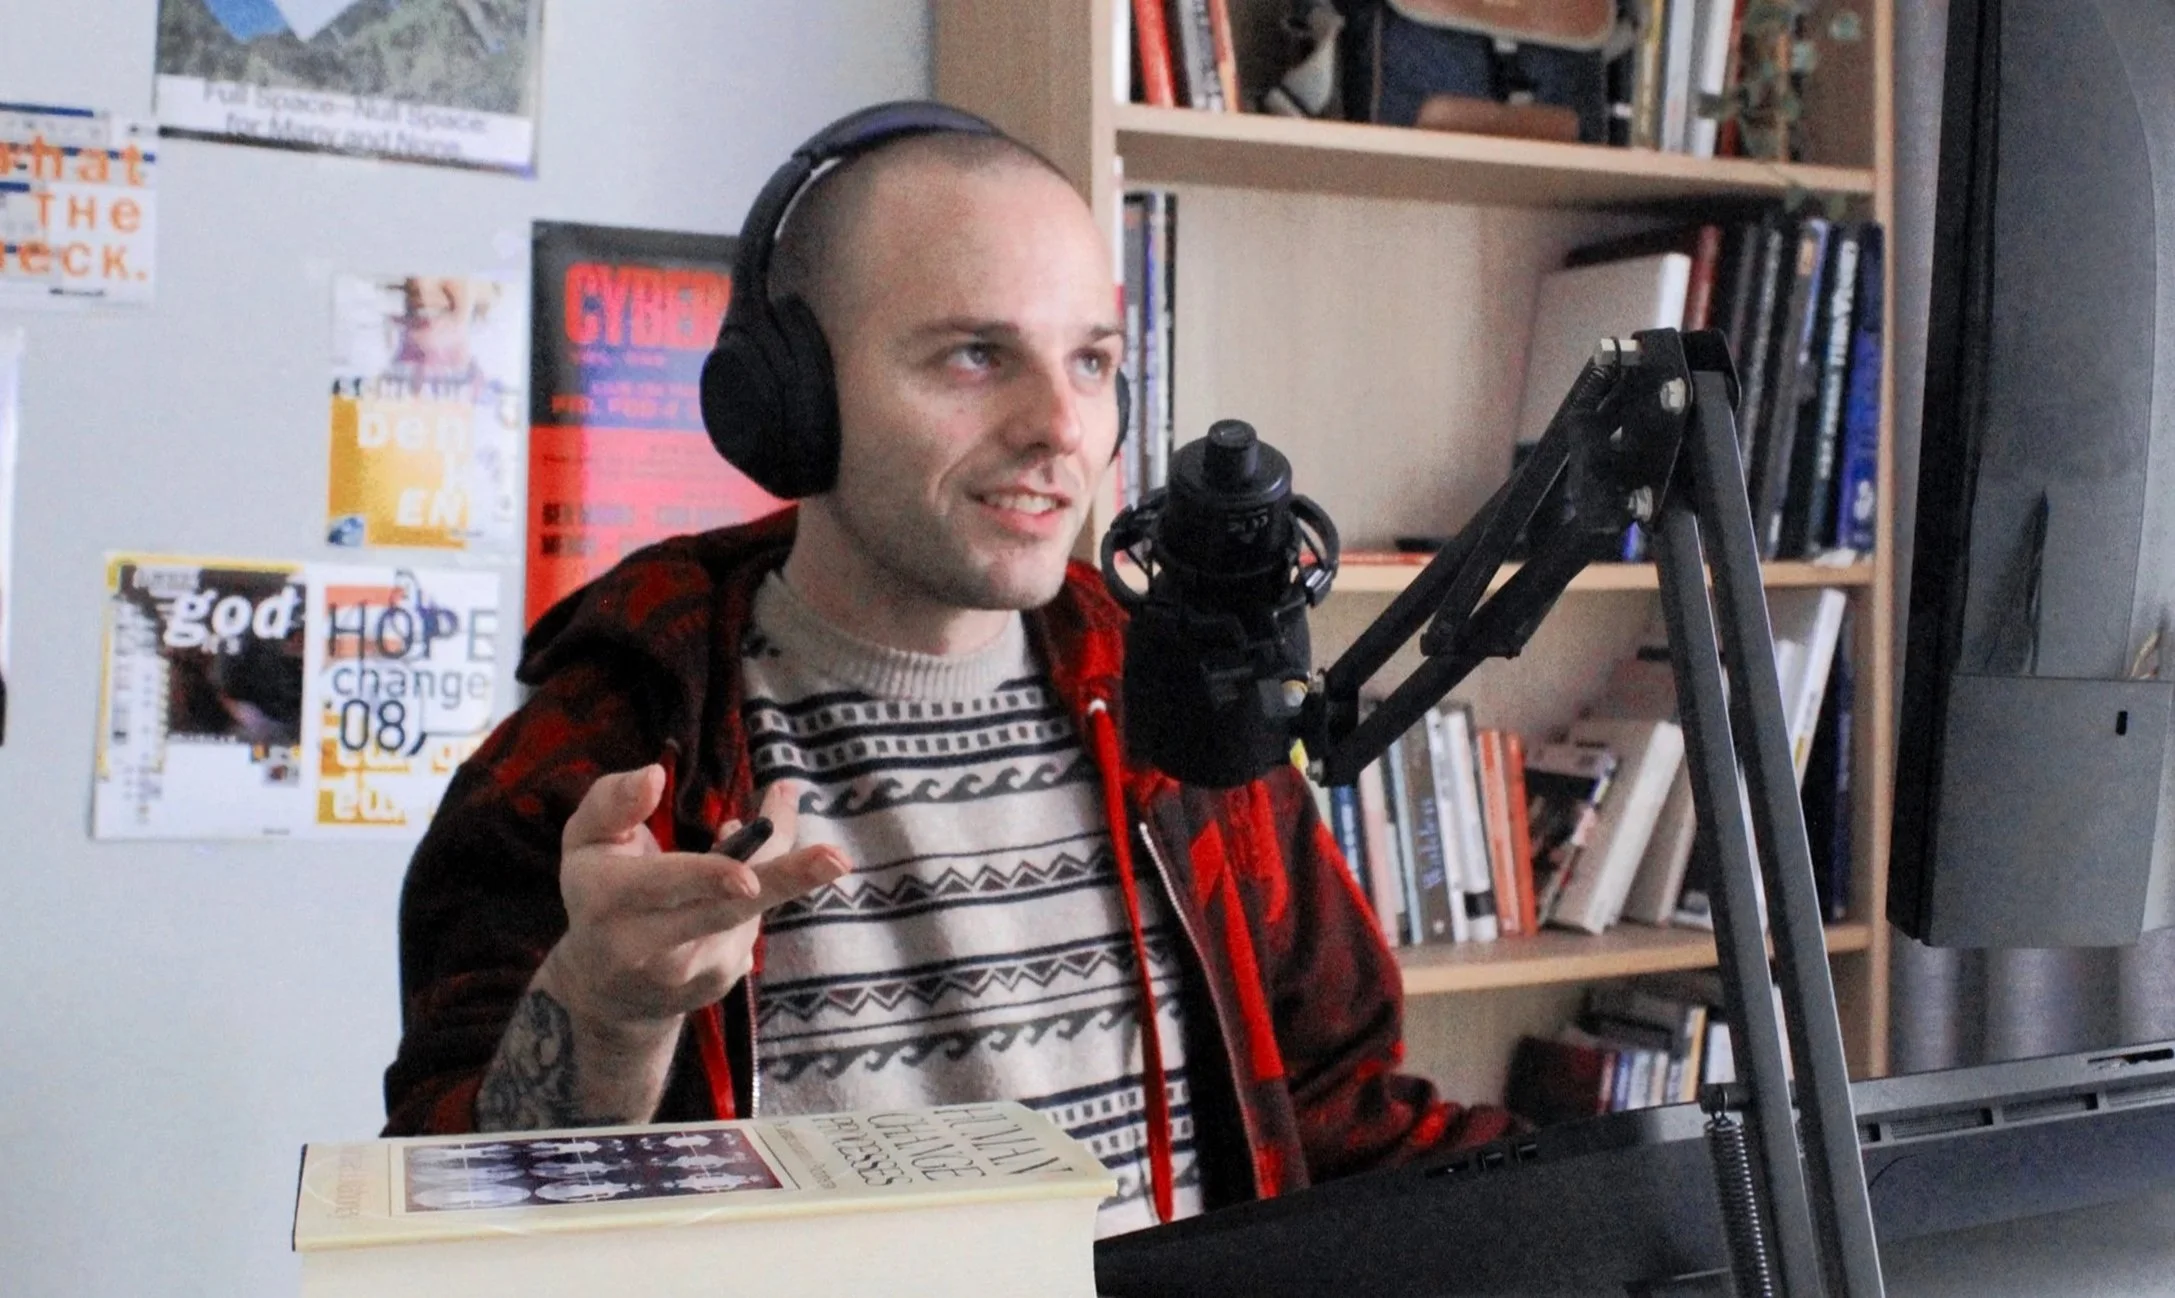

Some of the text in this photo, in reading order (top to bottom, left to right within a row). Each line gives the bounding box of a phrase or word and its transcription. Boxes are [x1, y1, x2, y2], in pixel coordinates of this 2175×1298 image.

[329, 603, 497, 660] HOPE
[333, 667, 487, 709] change
[866, 1112, 988, 1182] CHANGE
[933, 1106, 1074, 1176] HUMAN
